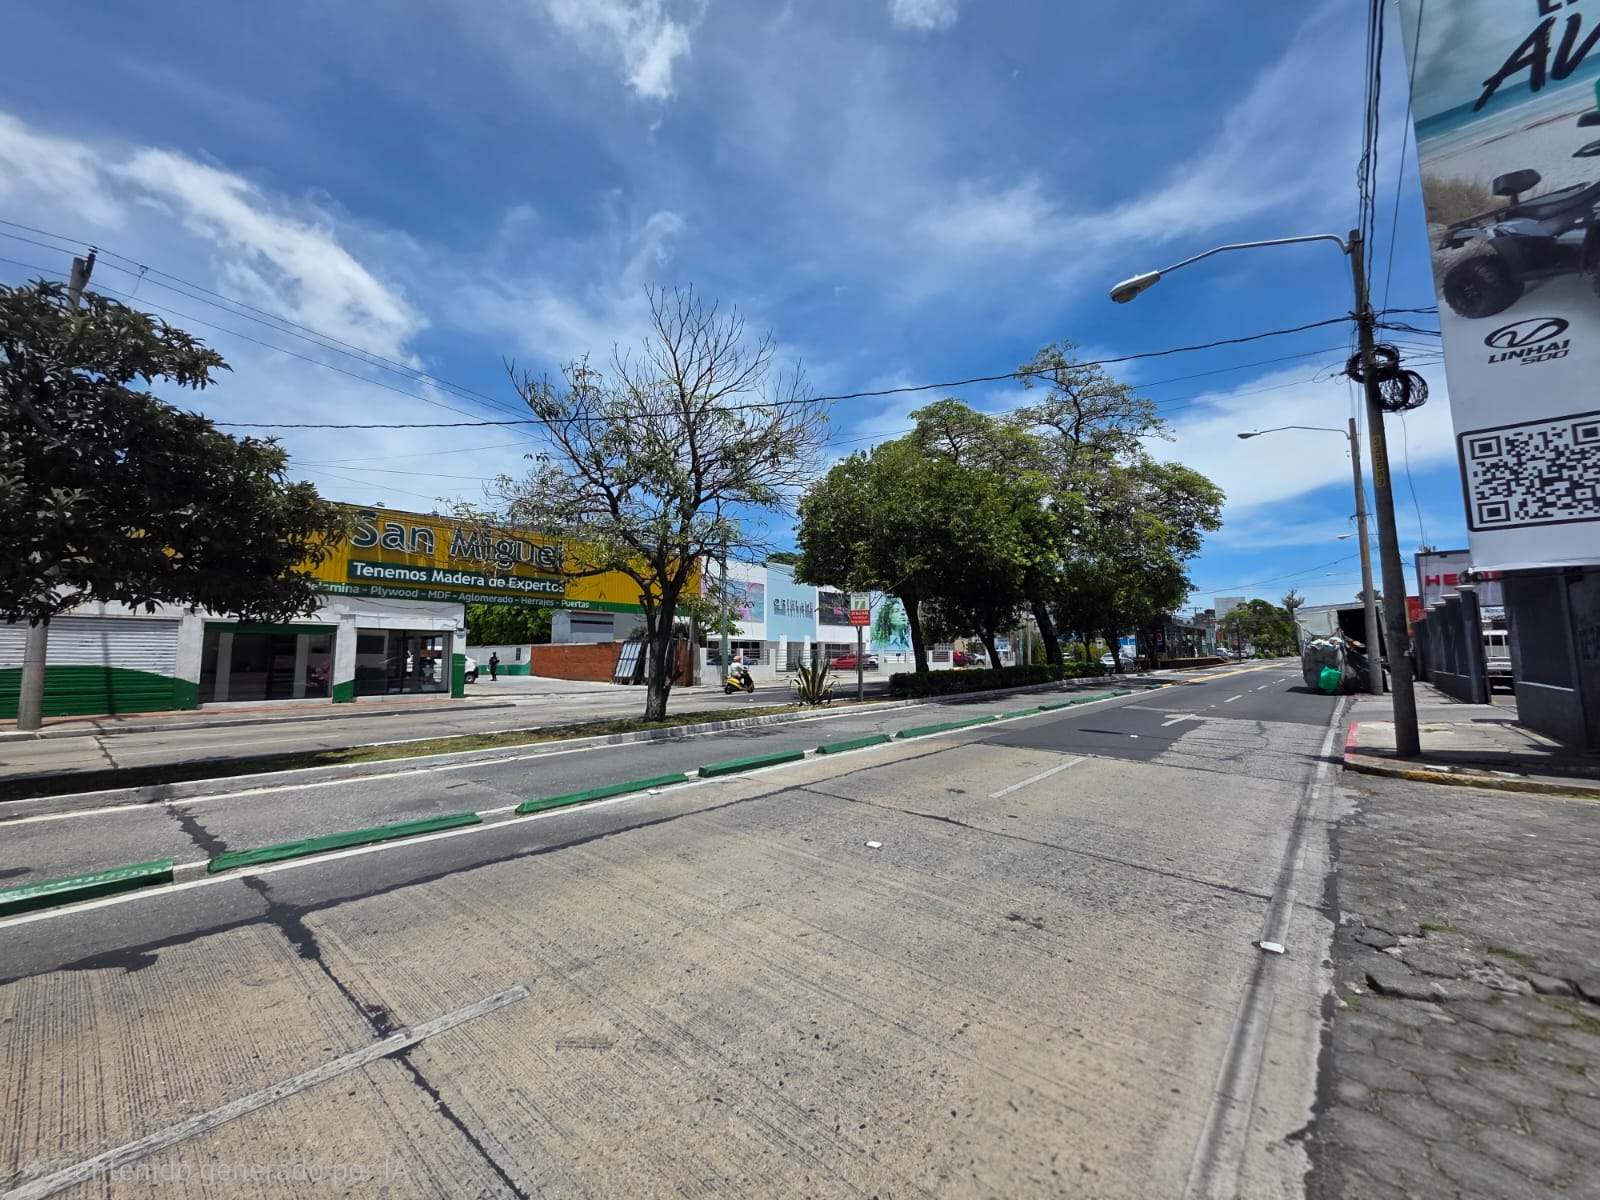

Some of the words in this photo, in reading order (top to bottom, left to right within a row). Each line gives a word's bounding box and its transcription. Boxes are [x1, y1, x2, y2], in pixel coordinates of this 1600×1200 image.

[1488, 339, 1570, 364] LINHAI
[1520, 349, 1569, 366] 500
[351, 509, 436, 554] San
[449, 525, 564, 571] Miguel
[353, 562, 427, 581] Tenemos
[432, 569, 485, 586] Madera
[488, 577, 506, 588] de
[508, 577, 565, 593] Expertos
[370, 585, 419, 598] Plywood
[427, 590, 452, 600] MDF
[459, 592, 514, 606] Aglomerado
[520, 597, 555, 608] Herrajes
[561, 600, 590, 609] Puertas
